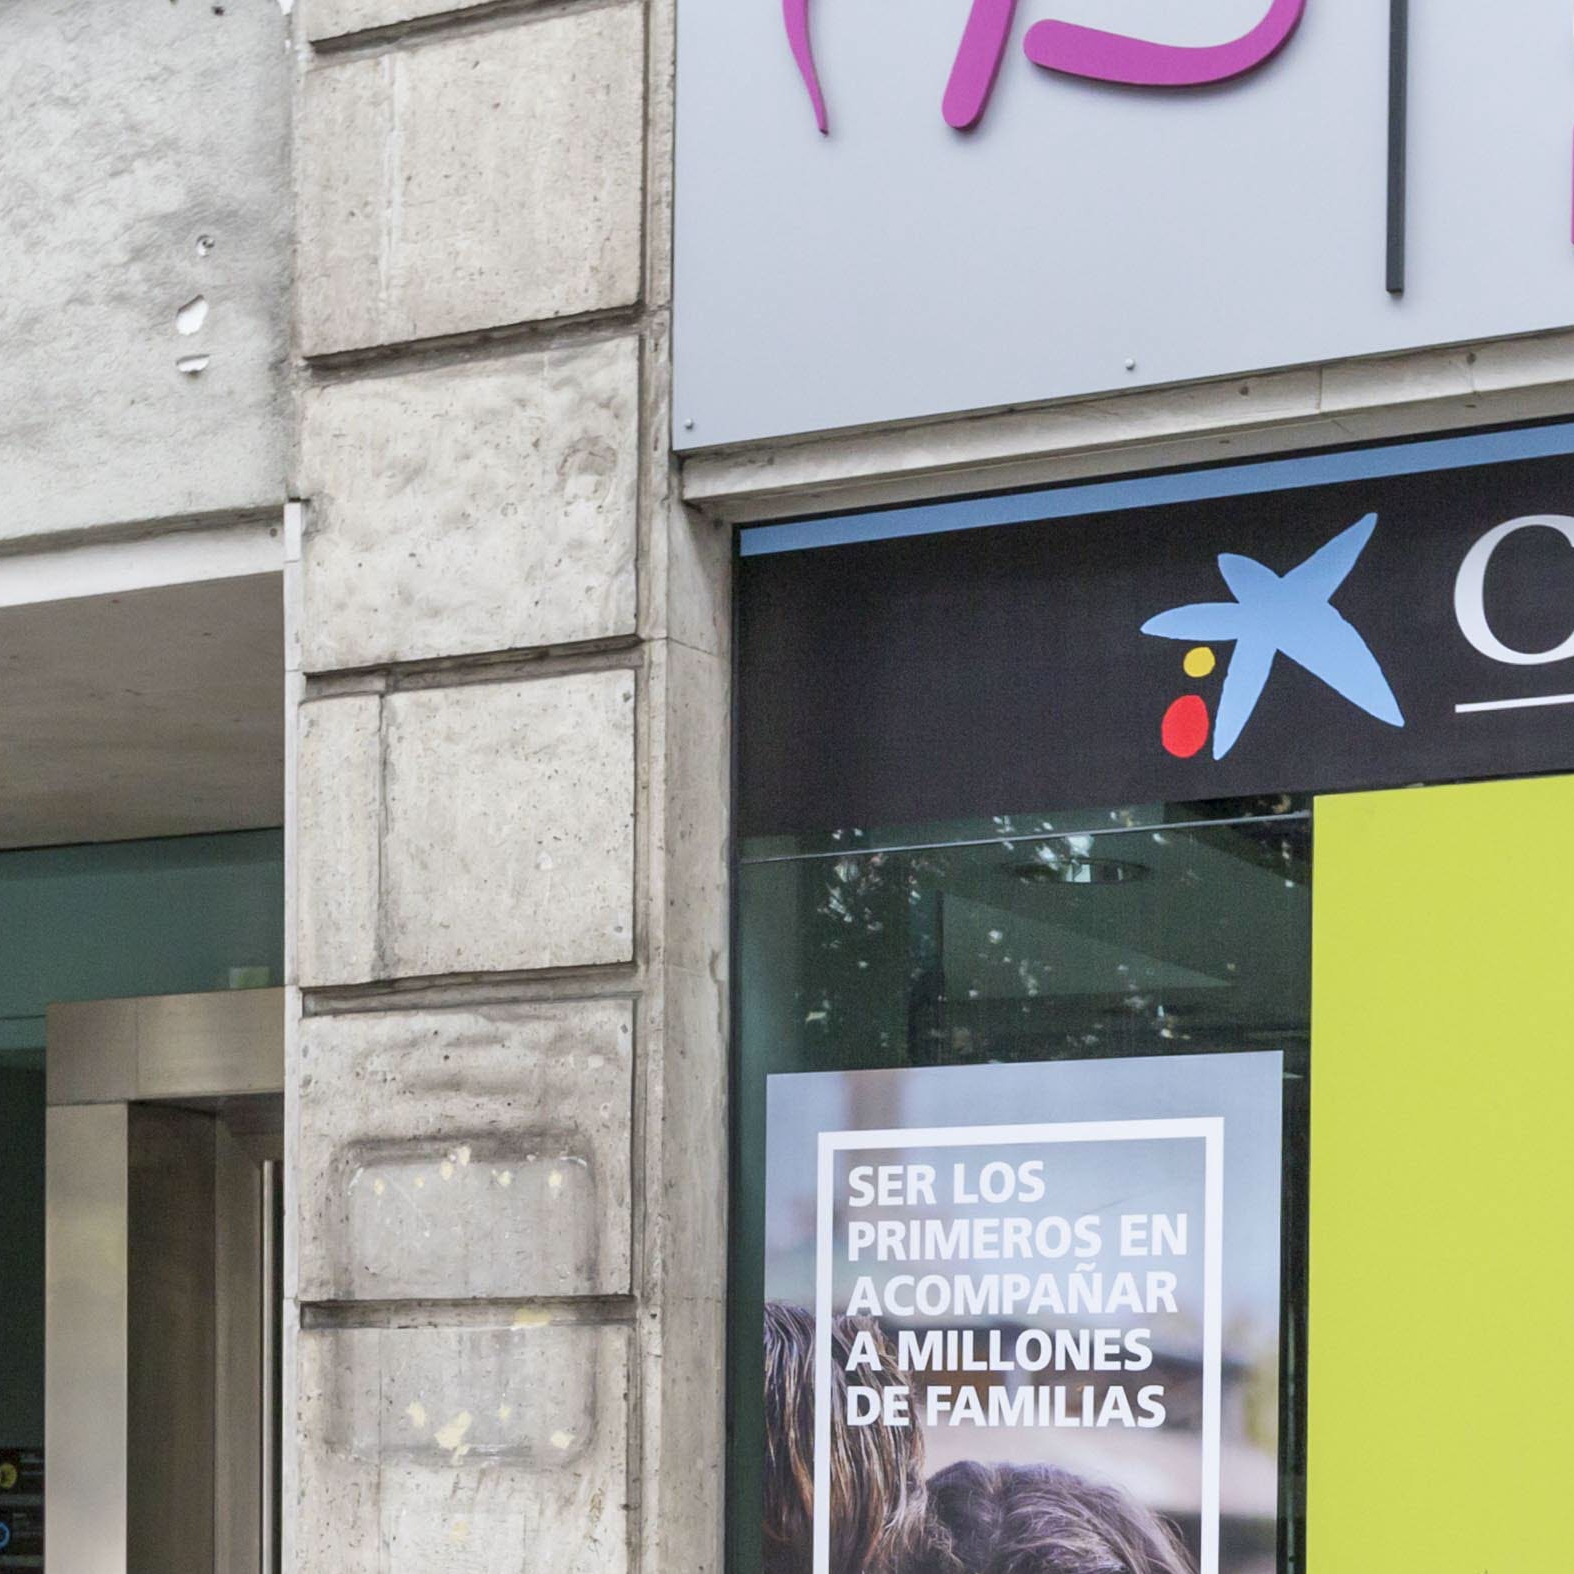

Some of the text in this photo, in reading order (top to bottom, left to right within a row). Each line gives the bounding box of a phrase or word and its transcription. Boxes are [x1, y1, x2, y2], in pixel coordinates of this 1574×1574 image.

[848, 1160, 1046, 1208] SER LOS
[848, 1213, 1188, 1262] PRIMEROS EN
[846, 1261, 1179, 1317] ACOMPAÑAR
[845, 1328, 1154, 1372] A MILLONES
[846, 1384, 1167, 1428] DE FAMILIAS
